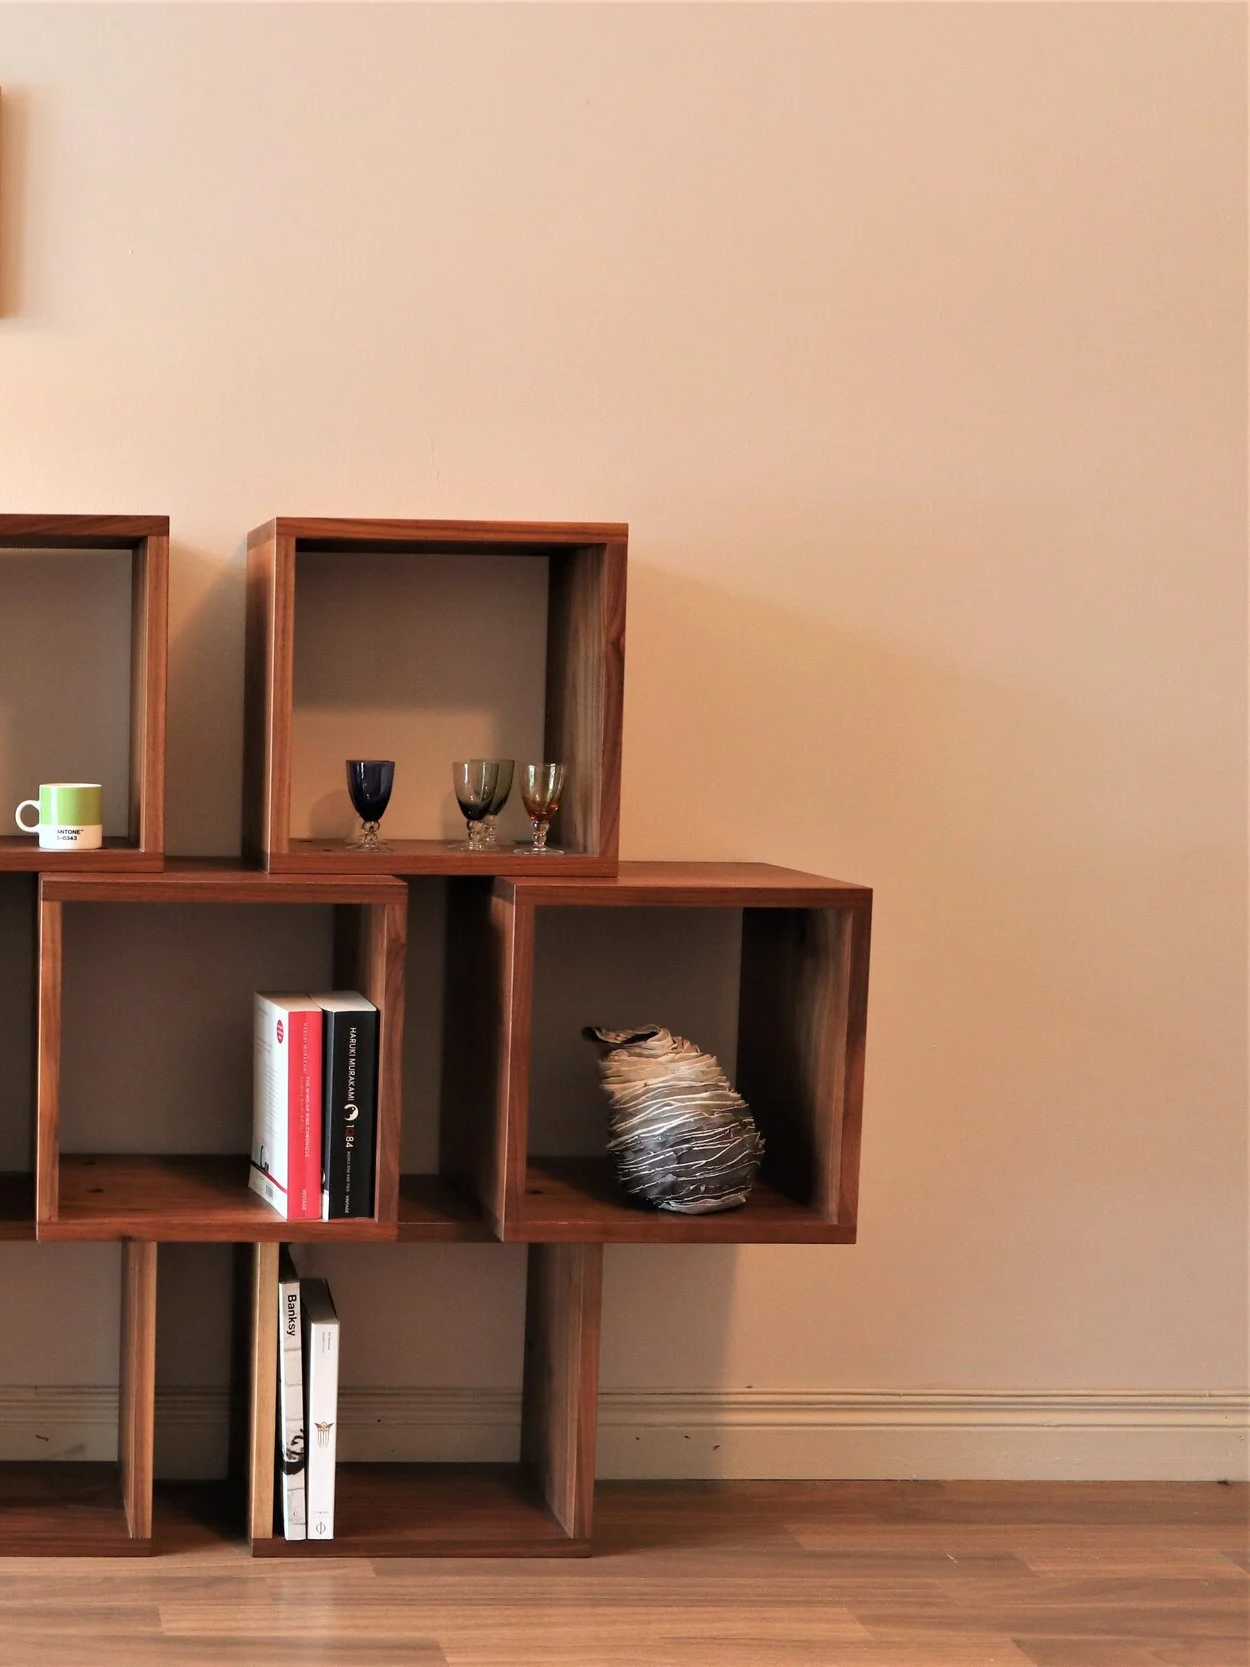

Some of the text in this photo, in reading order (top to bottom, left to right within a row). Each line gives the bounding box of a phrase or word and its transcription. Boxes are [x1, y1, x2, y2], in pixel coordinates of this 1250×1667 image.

[349, 1027, 357, 1057] HARUKI
[347, 1058, 356, 1101] MURAKAMI
[286, 1294, 297, 1337] Banksy
